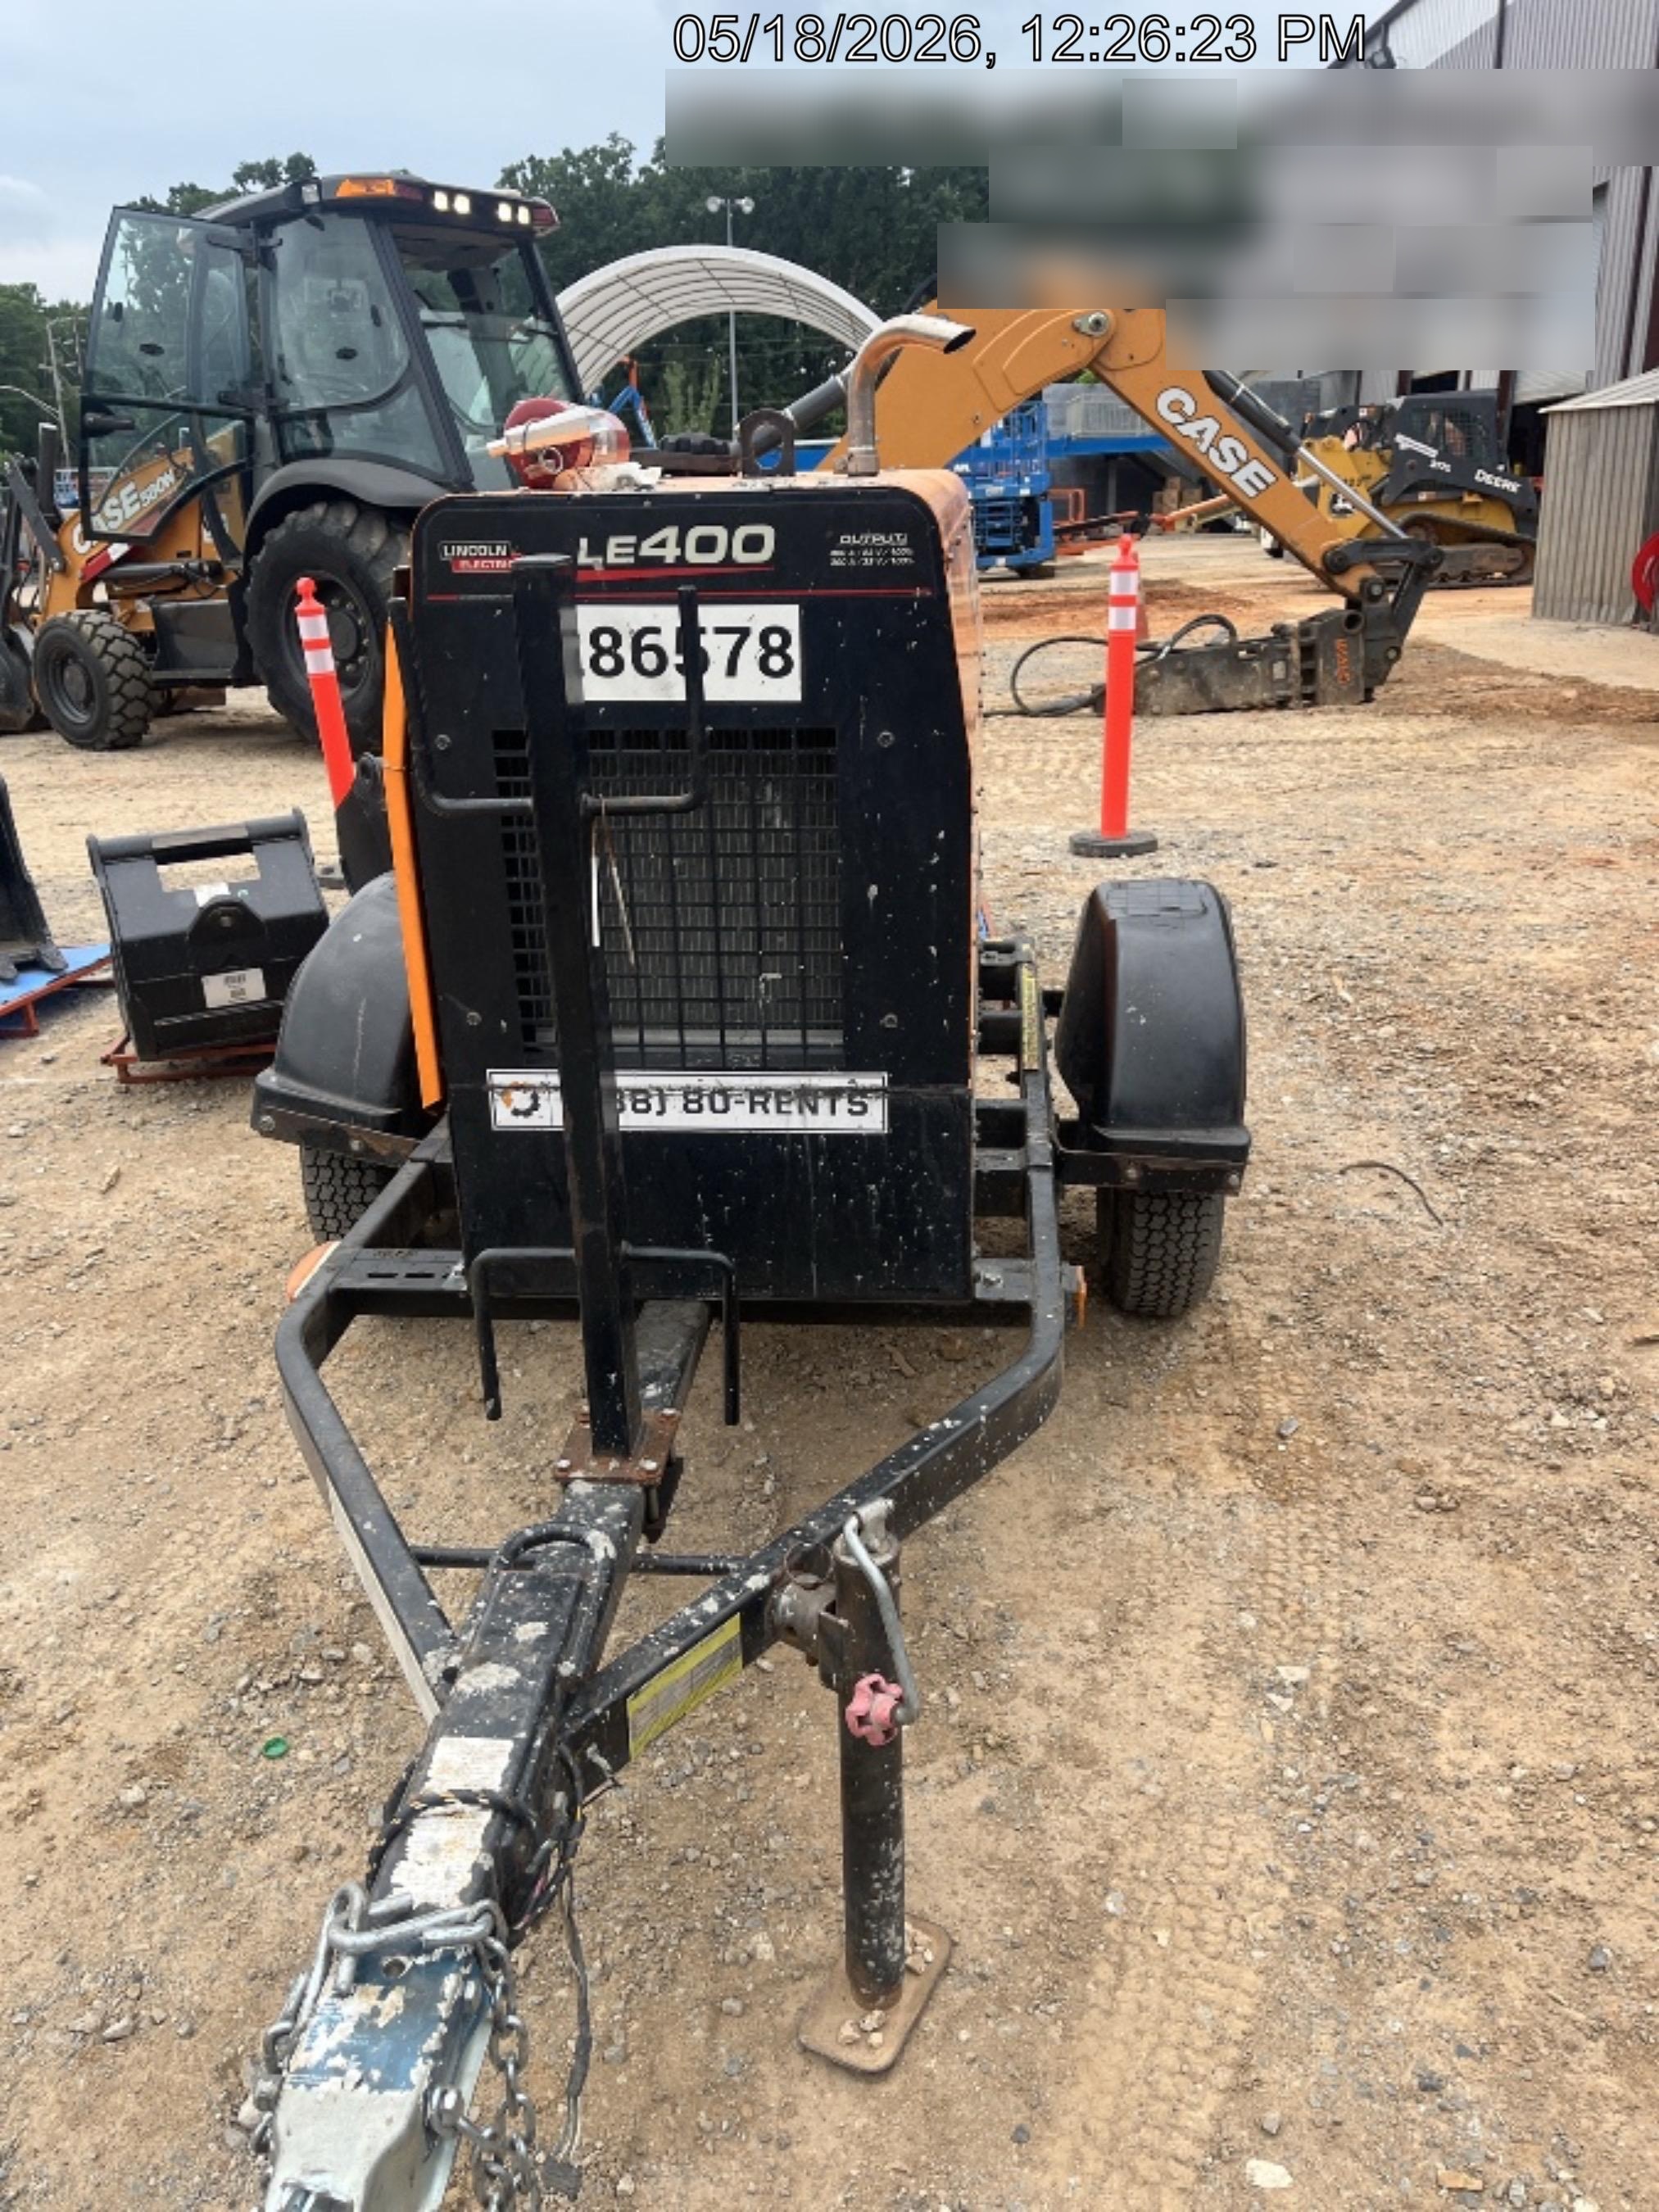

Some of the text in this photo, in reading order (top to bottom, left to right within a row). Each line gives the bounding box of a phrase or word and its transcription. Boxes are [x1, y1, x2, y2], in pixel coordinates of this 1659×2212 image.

[1157, 387, 1277, 498] CASE
[443, 544, 507, 556] LINCOLN
[577, 524, 775, 565] LE400
[578, 625, 795, 678] 86578
